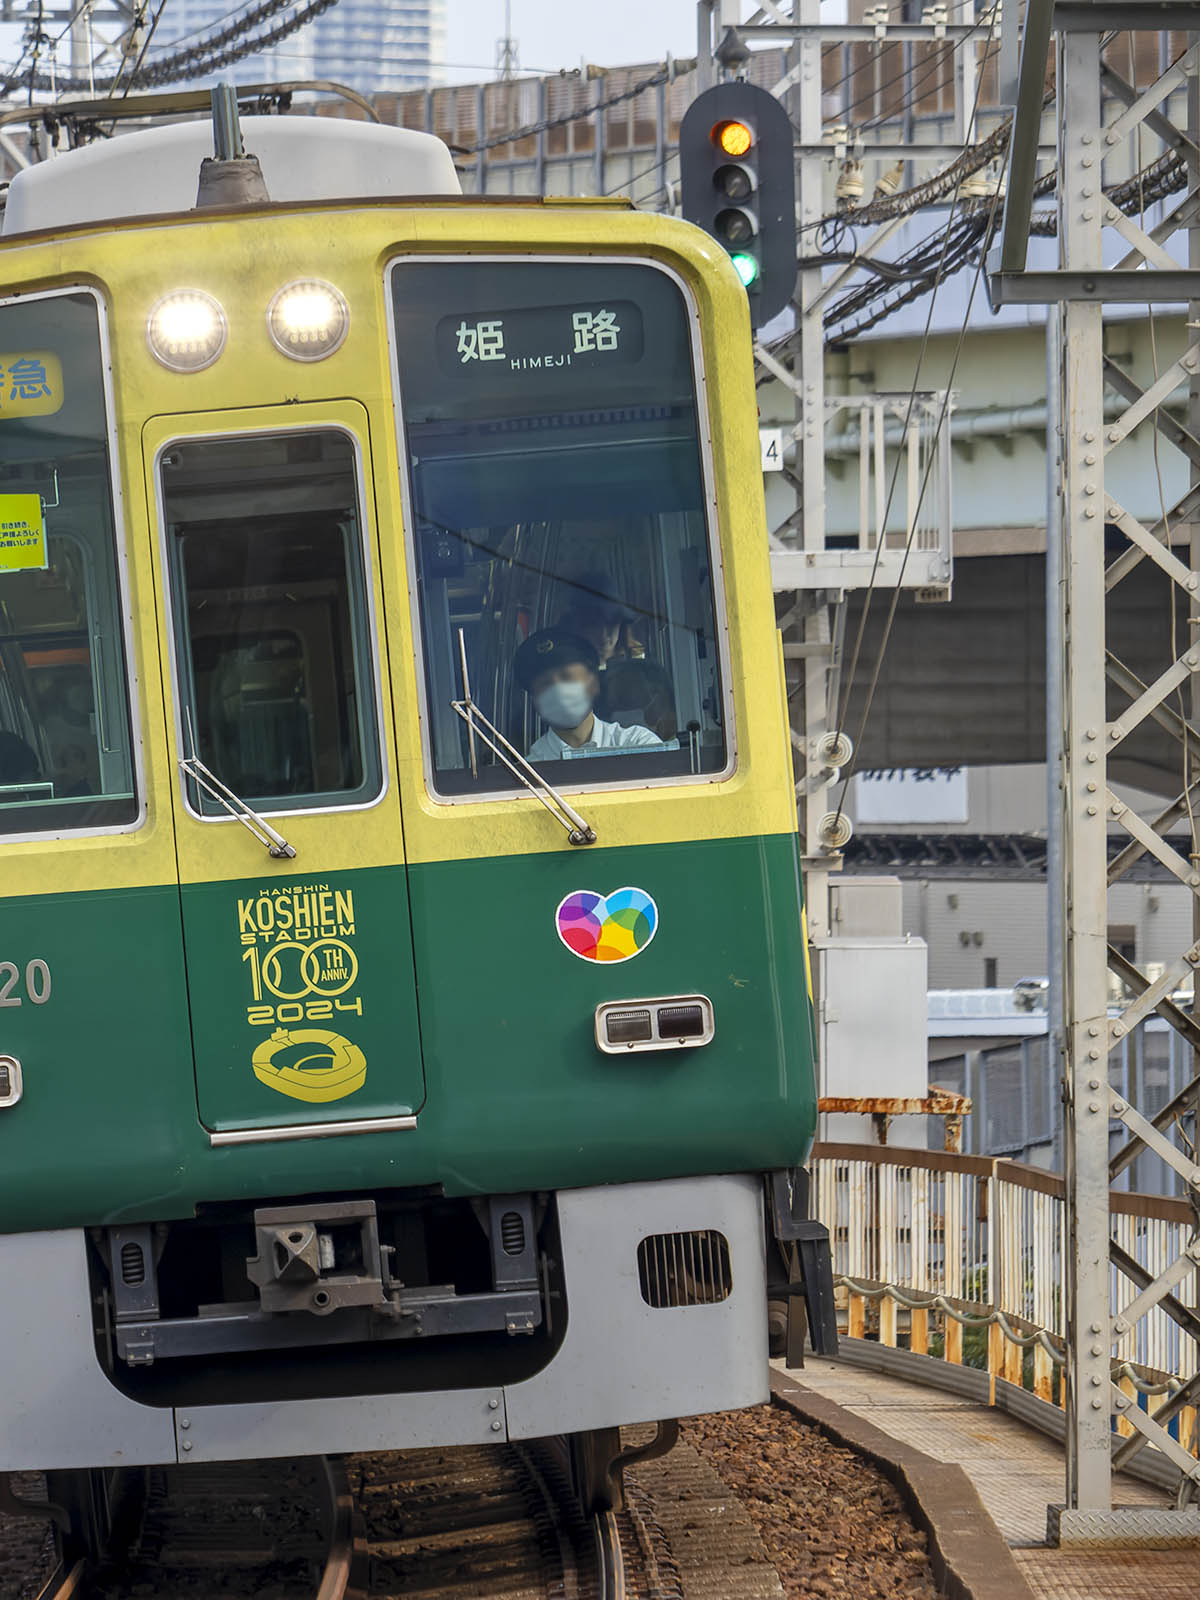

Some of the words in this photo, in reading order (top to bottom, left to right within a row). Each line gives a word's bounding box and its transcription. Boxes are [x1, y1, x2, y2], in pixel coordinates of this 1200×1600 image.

[510, 354, 572, 370] HIMEJI
[766, 439, 779, 462] 4
[259, 884, 329, 897] HANSHIN
[237, 889, 355, 933] KOSHIEN
[240, 924, 356, 945] STADIUM
[322, 948, 344, 969] TH
[242, 938, 359, 1001] 100
[320, 967, 350, 982] ANNIV.
[246, 996, 363, 1026] 2024
